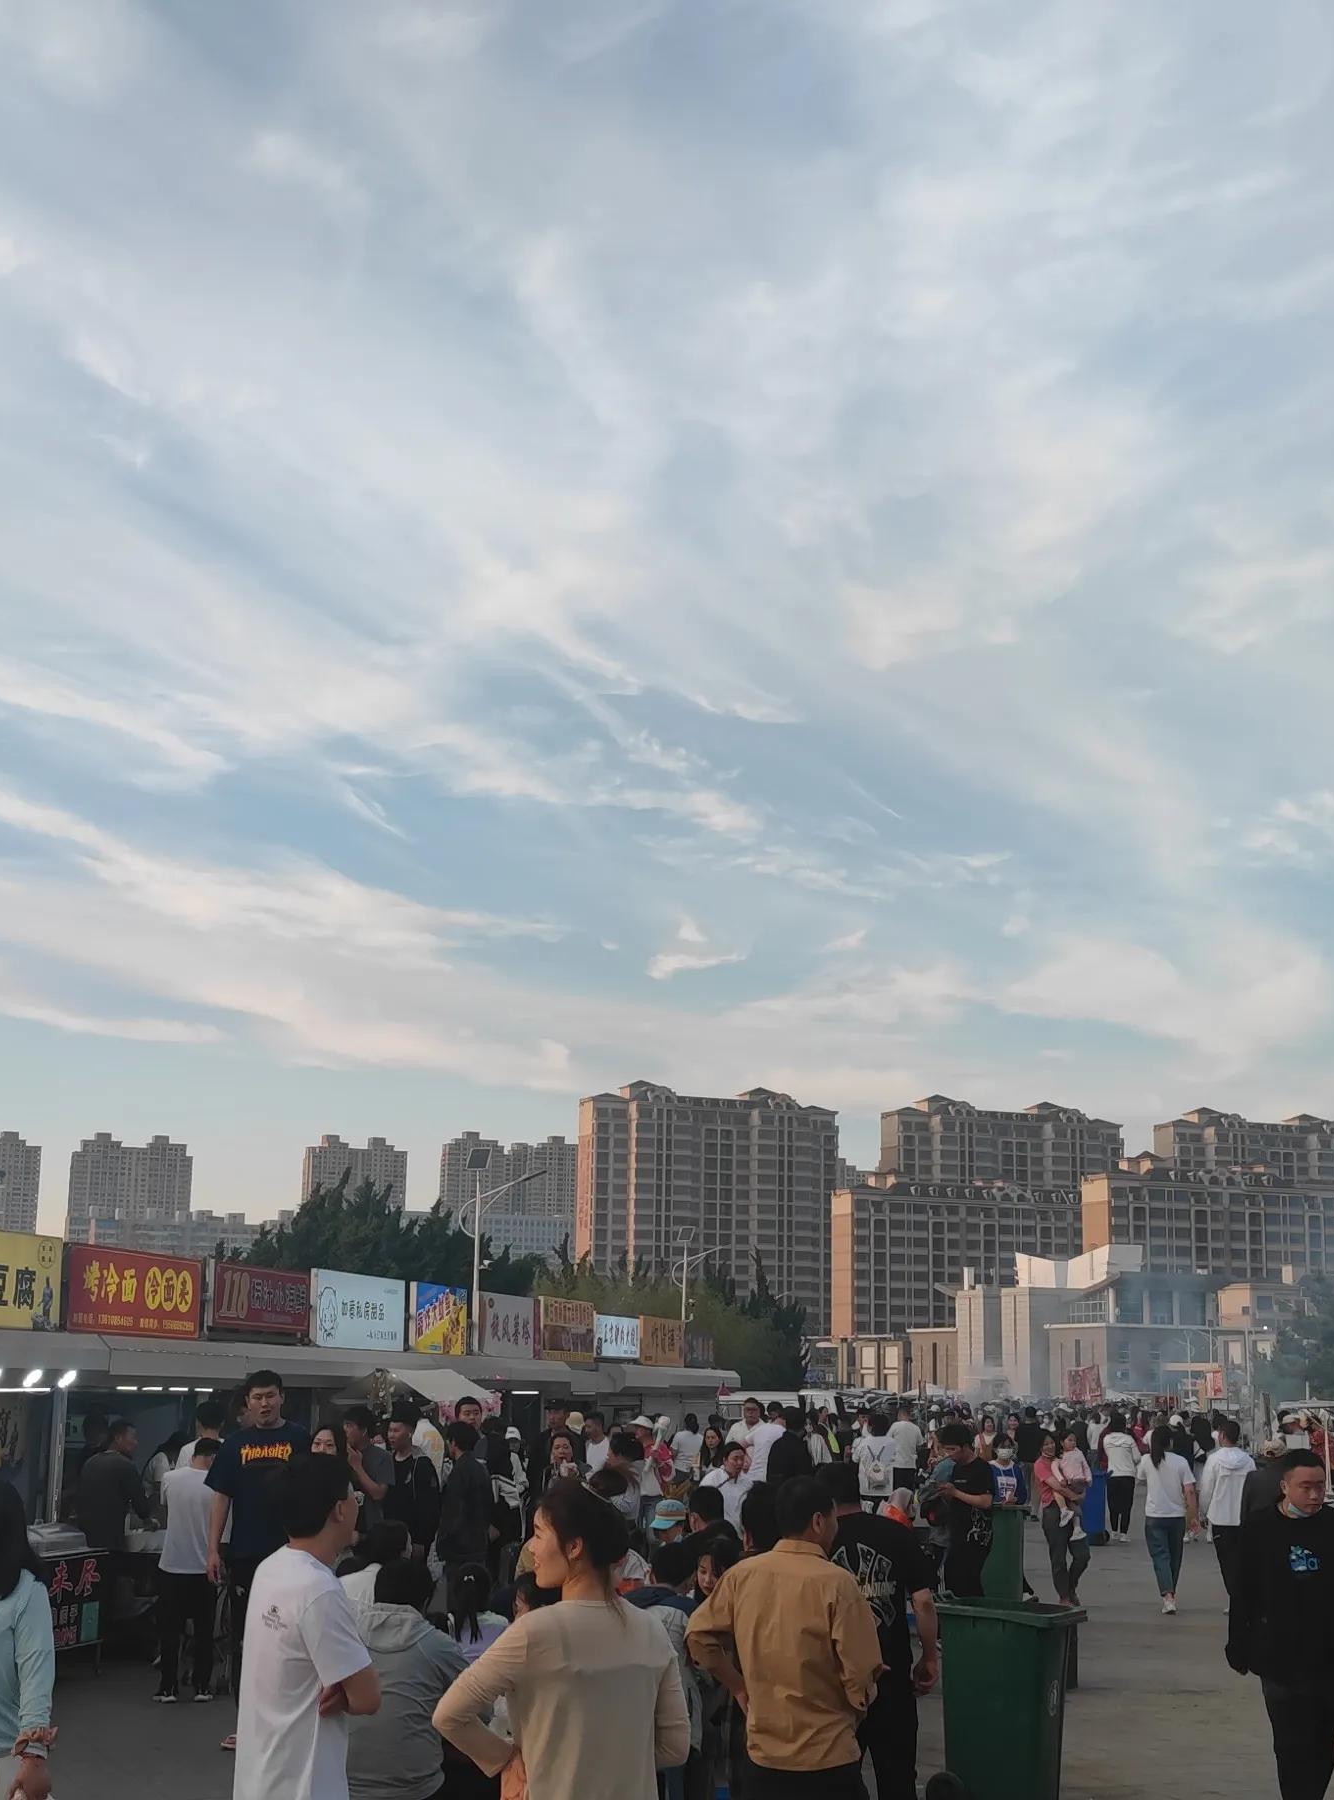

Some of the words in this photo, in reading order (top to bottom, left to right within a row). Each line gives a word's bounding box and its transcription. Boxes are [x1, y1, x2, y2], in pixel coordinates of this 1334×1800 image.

[83, 1260, 137, 1305] 烤冷面
[218, 1269, 251, 1319] 118
[240, 1442, 293, 1465] THRASHER
